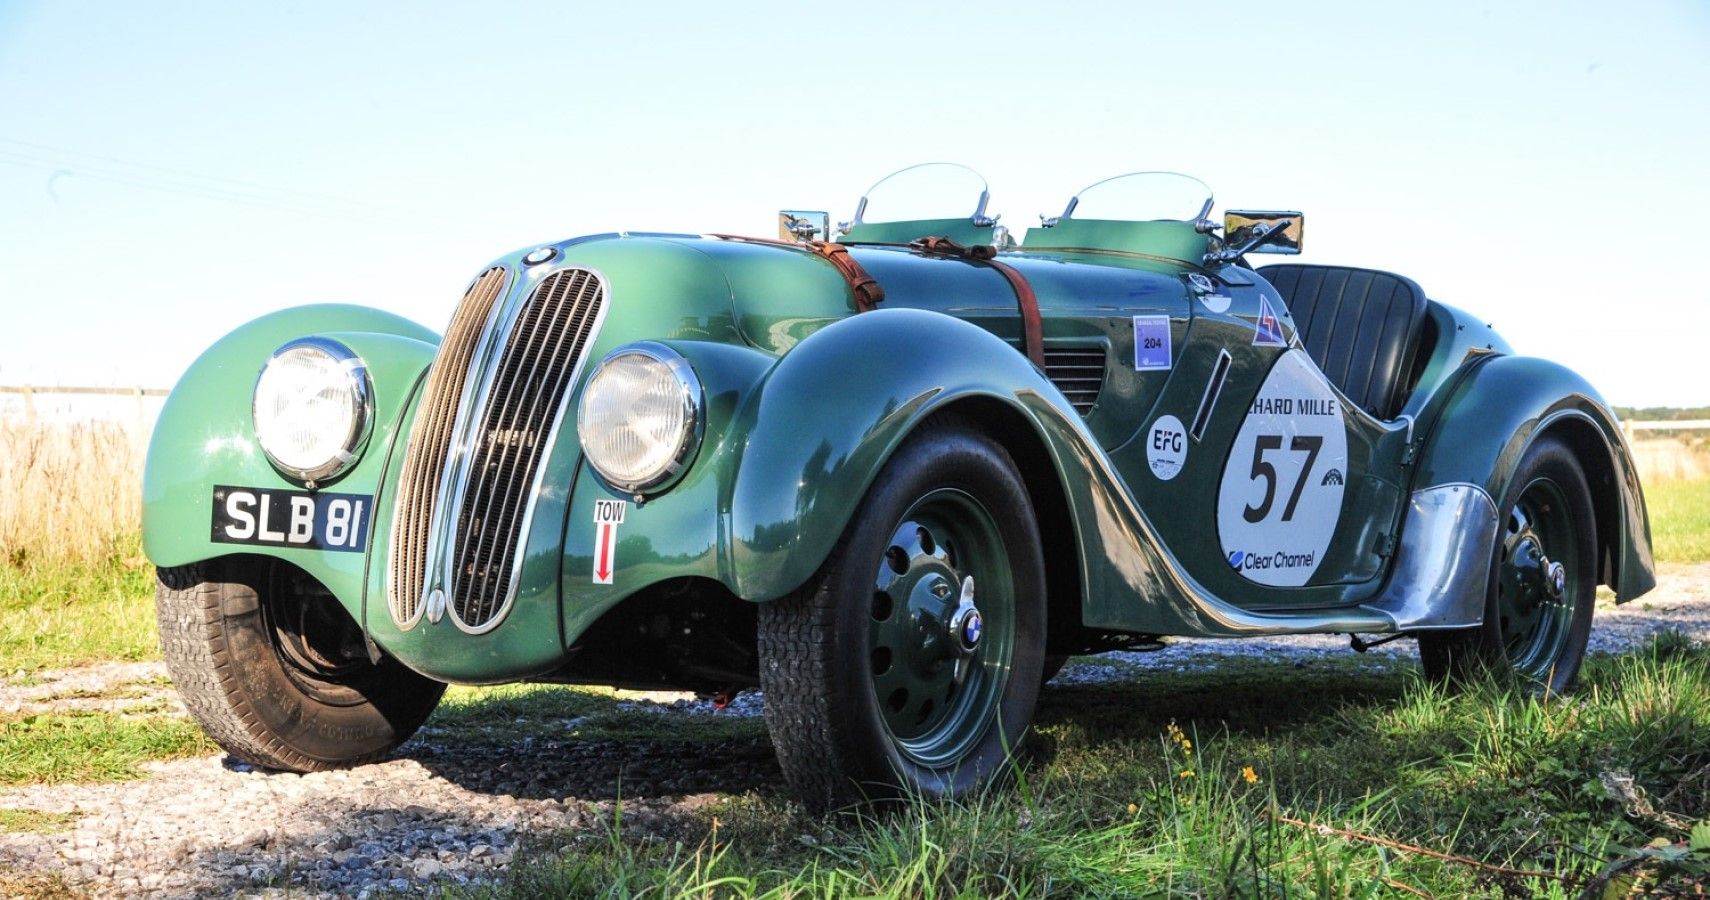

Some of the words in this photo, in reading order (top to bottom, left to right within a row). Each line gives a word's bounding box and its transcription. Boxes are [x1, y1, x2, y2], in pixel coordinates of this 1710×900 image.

[1144, 337, 1162, 349] 204
[1297, 399, 1335, 416] MILLE
[1154, 429, 1182, 453] EFG
[1243, 435, 1323, 523] 57
[225, 491, 315, 544] SLB
[325, 499, 363, 547] 81
[597, 501, 625, 521] TOW
[1245, 552, 1273, 570] Clear
[1274, 550, 1315, 568] Channel
